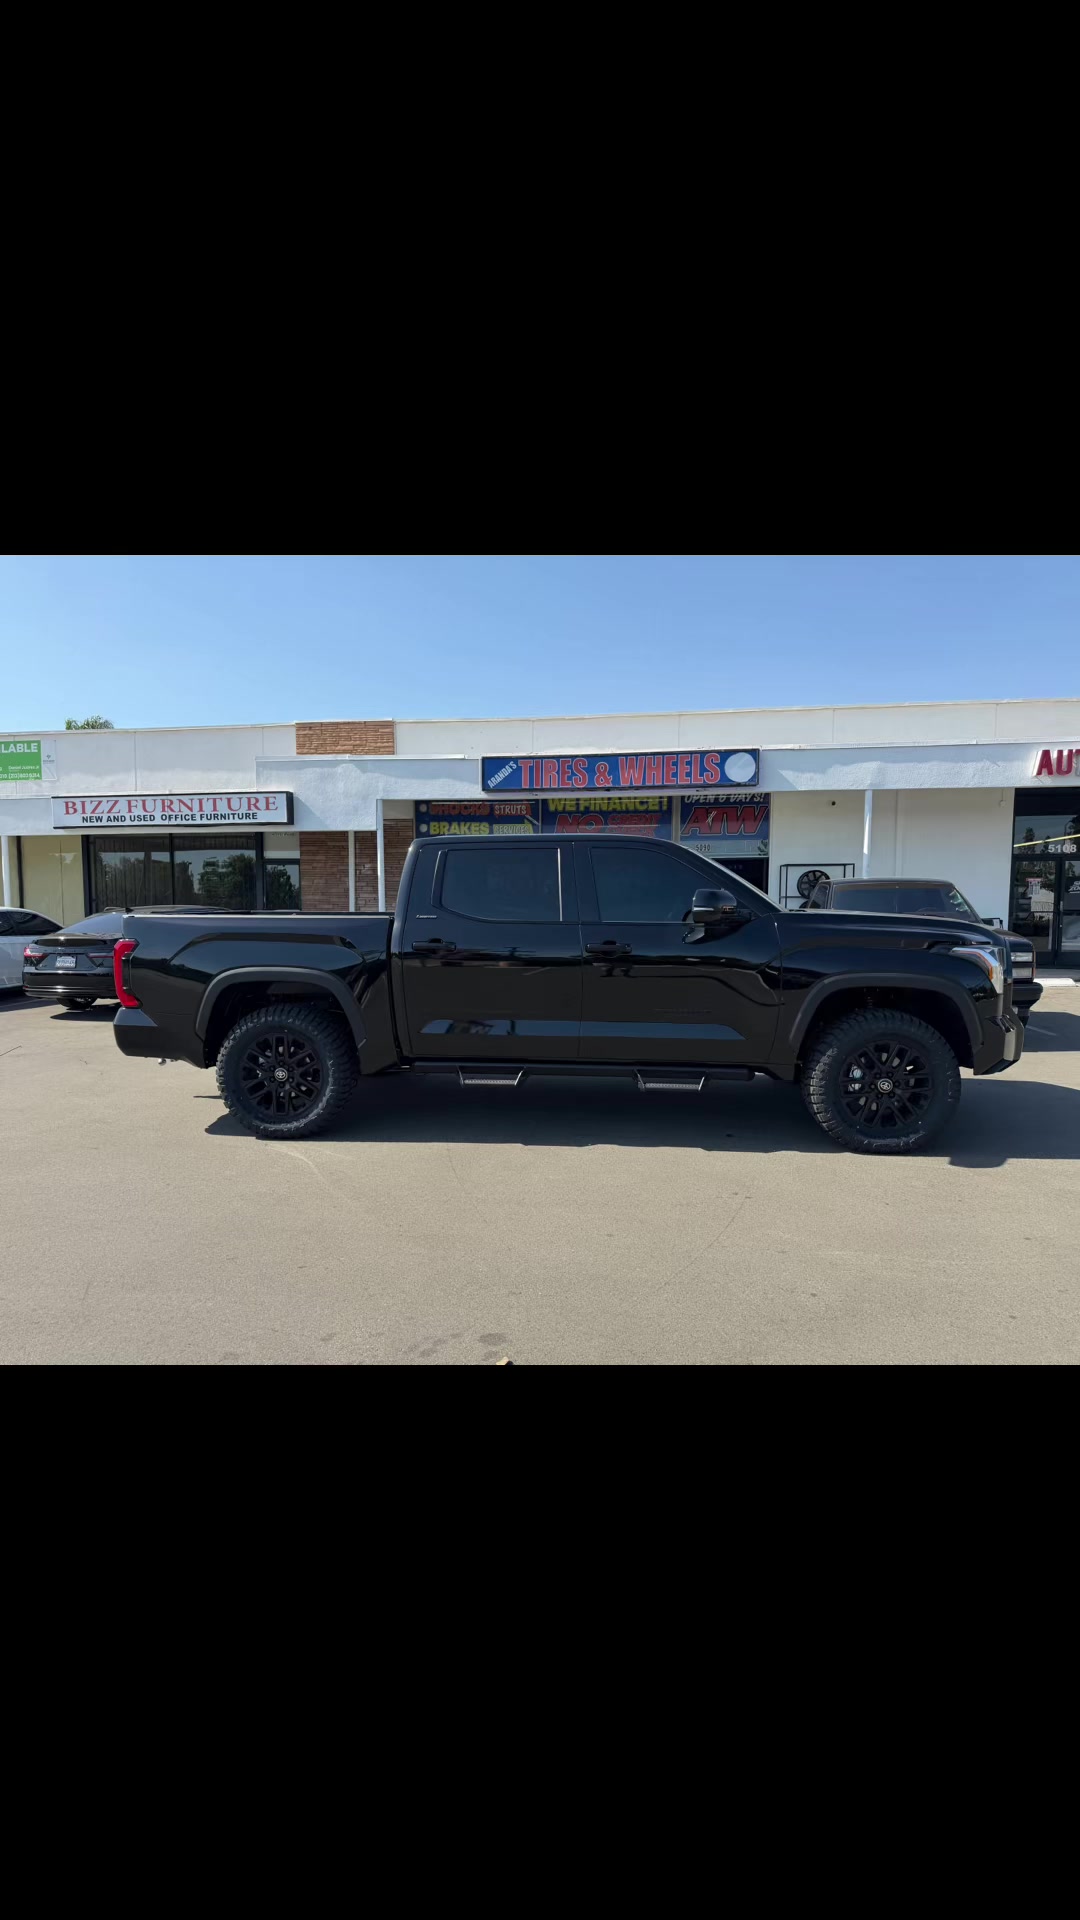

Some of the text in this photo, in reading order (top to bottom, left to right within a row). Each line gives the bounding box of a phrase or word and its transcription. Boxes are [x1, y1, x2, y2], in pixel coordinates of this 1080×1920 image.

[487, 761, 517, 788] ARANDA'S
[518, 752, 720, 789] TIRES & WHEELS
[548, 797, 577, 812] WE
[684, 793, 716, 803] OPEN
[730, 791, 766, 803] DAYS!
[64, 796, 279, 815] BIZZ FURNITURE
[494, 804, 527, 815] STRUTS
[82, 812, 258, 824] NEW AND USED OFFICE FURNITURE
[554, 813, 604, 834] NO
[680, 805, 769, 836] ATW
[430, 822, 529, 835] BRAKES SERVICES
[1048, 844, 1077, 853] 5108
